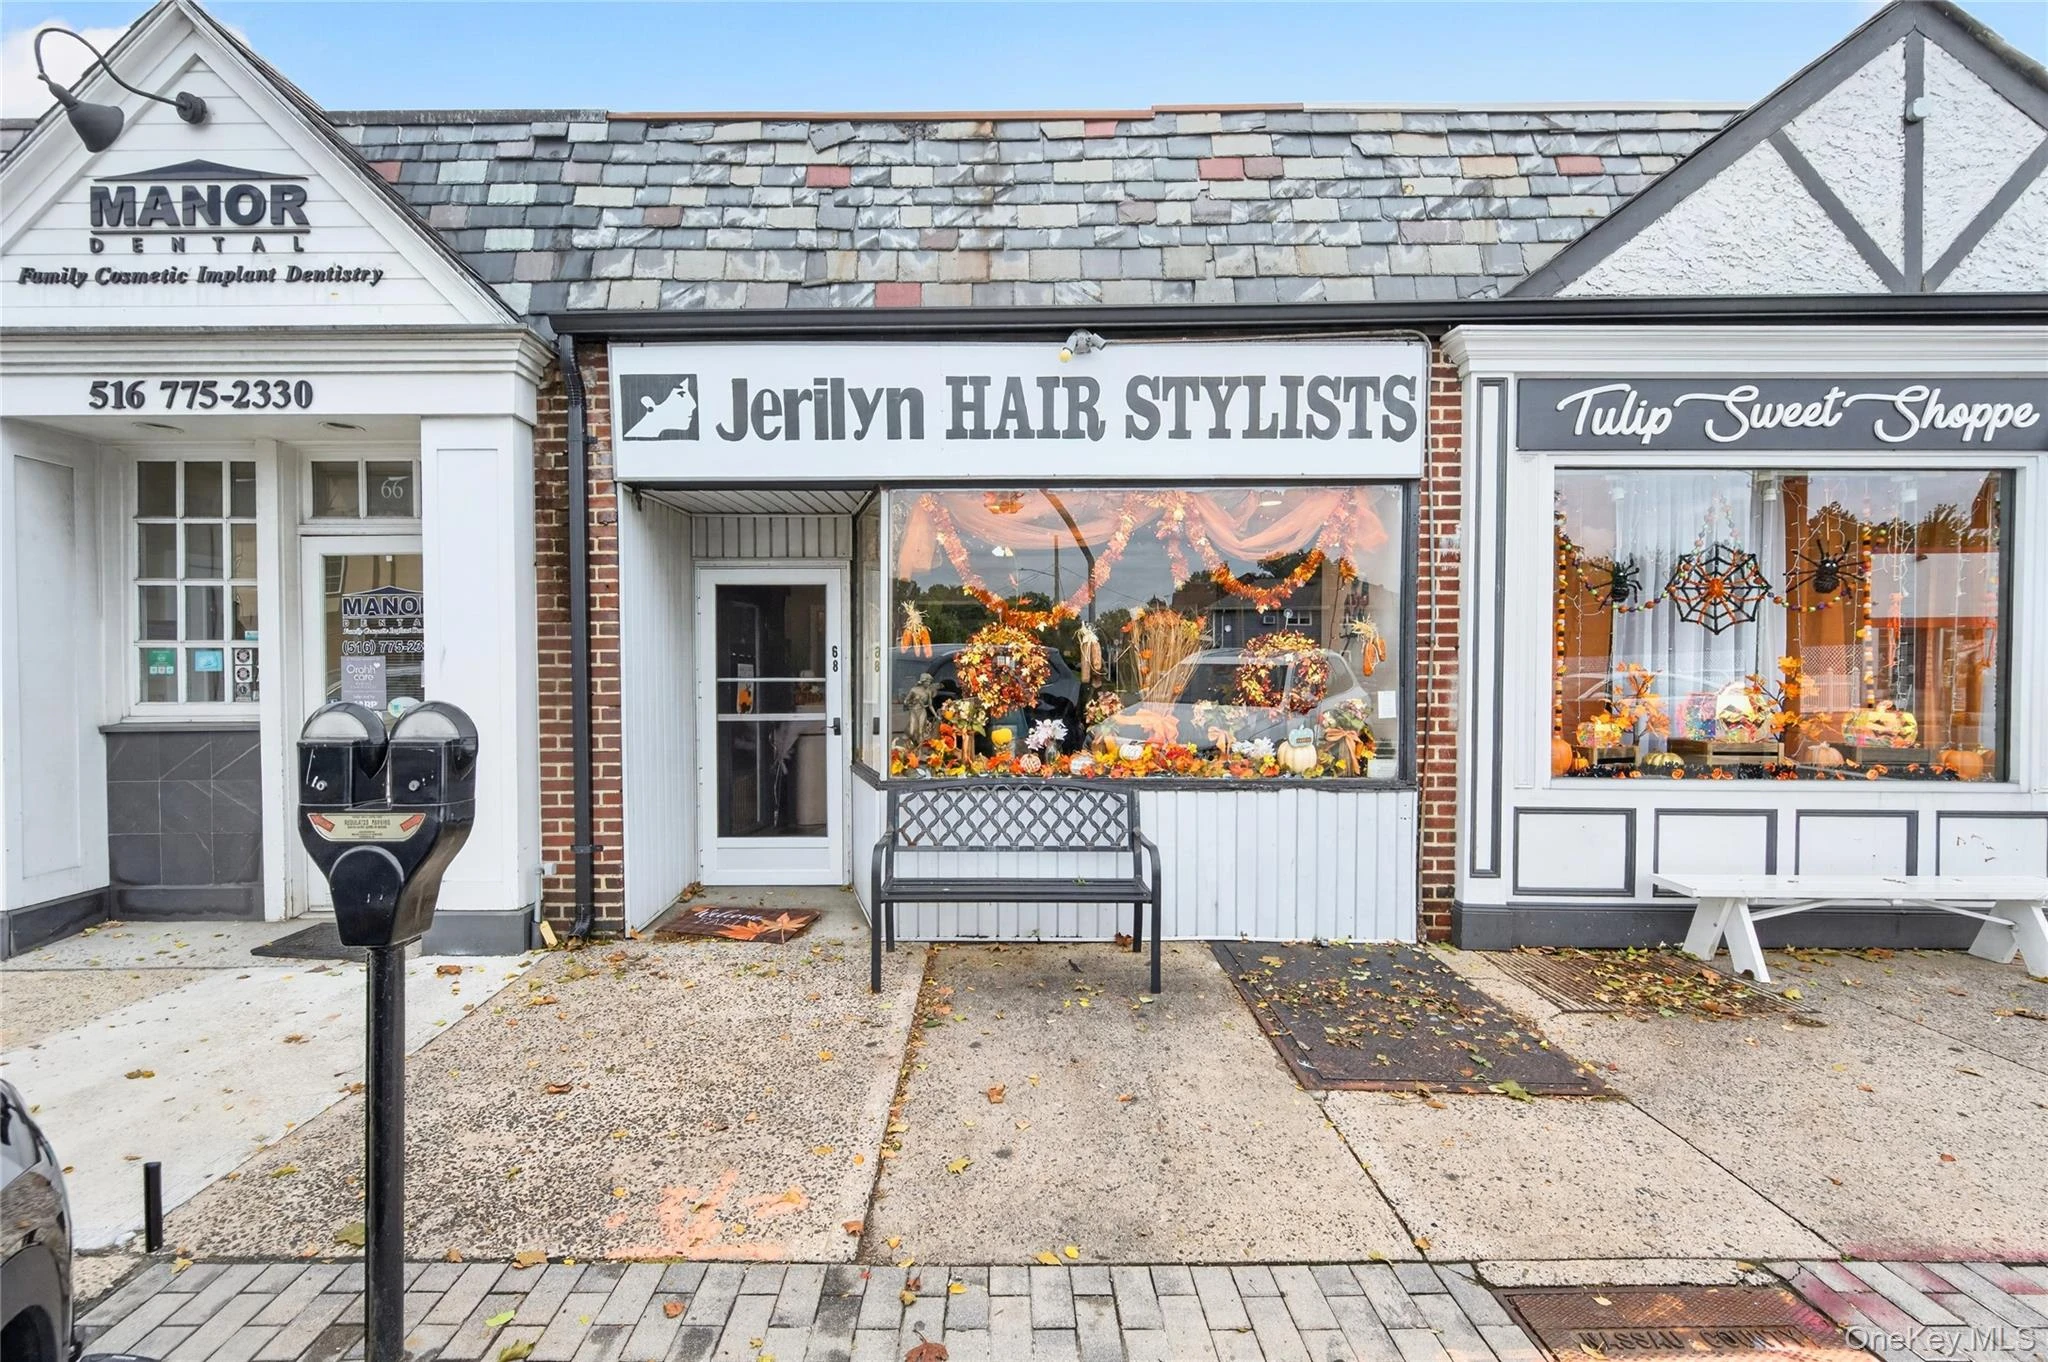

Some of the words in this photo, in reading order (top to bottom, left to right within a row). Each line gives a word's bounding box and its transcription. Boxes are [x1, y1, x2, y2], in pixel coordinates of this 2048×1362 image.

[89, 183, 311, 227] MANOR
[89, 236, 305, 253] DENTAL
[17, 266, 88, 289] Family
[95, 266, 189, 286] Cosmetic
[196, 265, 277, 287] Implant
[285, 264, 384, 287] Dentistry
[88, 379, 146, 410] 516
[159, 379, 314, 410] 775-2330
[715, 377, 926, 442] Jerilyn
[944, 375, 1107, 442] HAIR
[1125, 374, 1418, 443] STYLISTS
[1556, 383, 1674, 445] Tulip
[1673, 384, 1845, 443] Sweet
[1843, 384, 2041, 443] Shoppe
[381, 478, 404, 499] 66
[342, 596, 424, 615] MANO
[342, 640, 376, 655] (516)
[831, 645, 839, 672] 68
[1578, 1331, 1686, 1351] NASSAU
[1700, 1328, 1806, 1349] COUNTY
